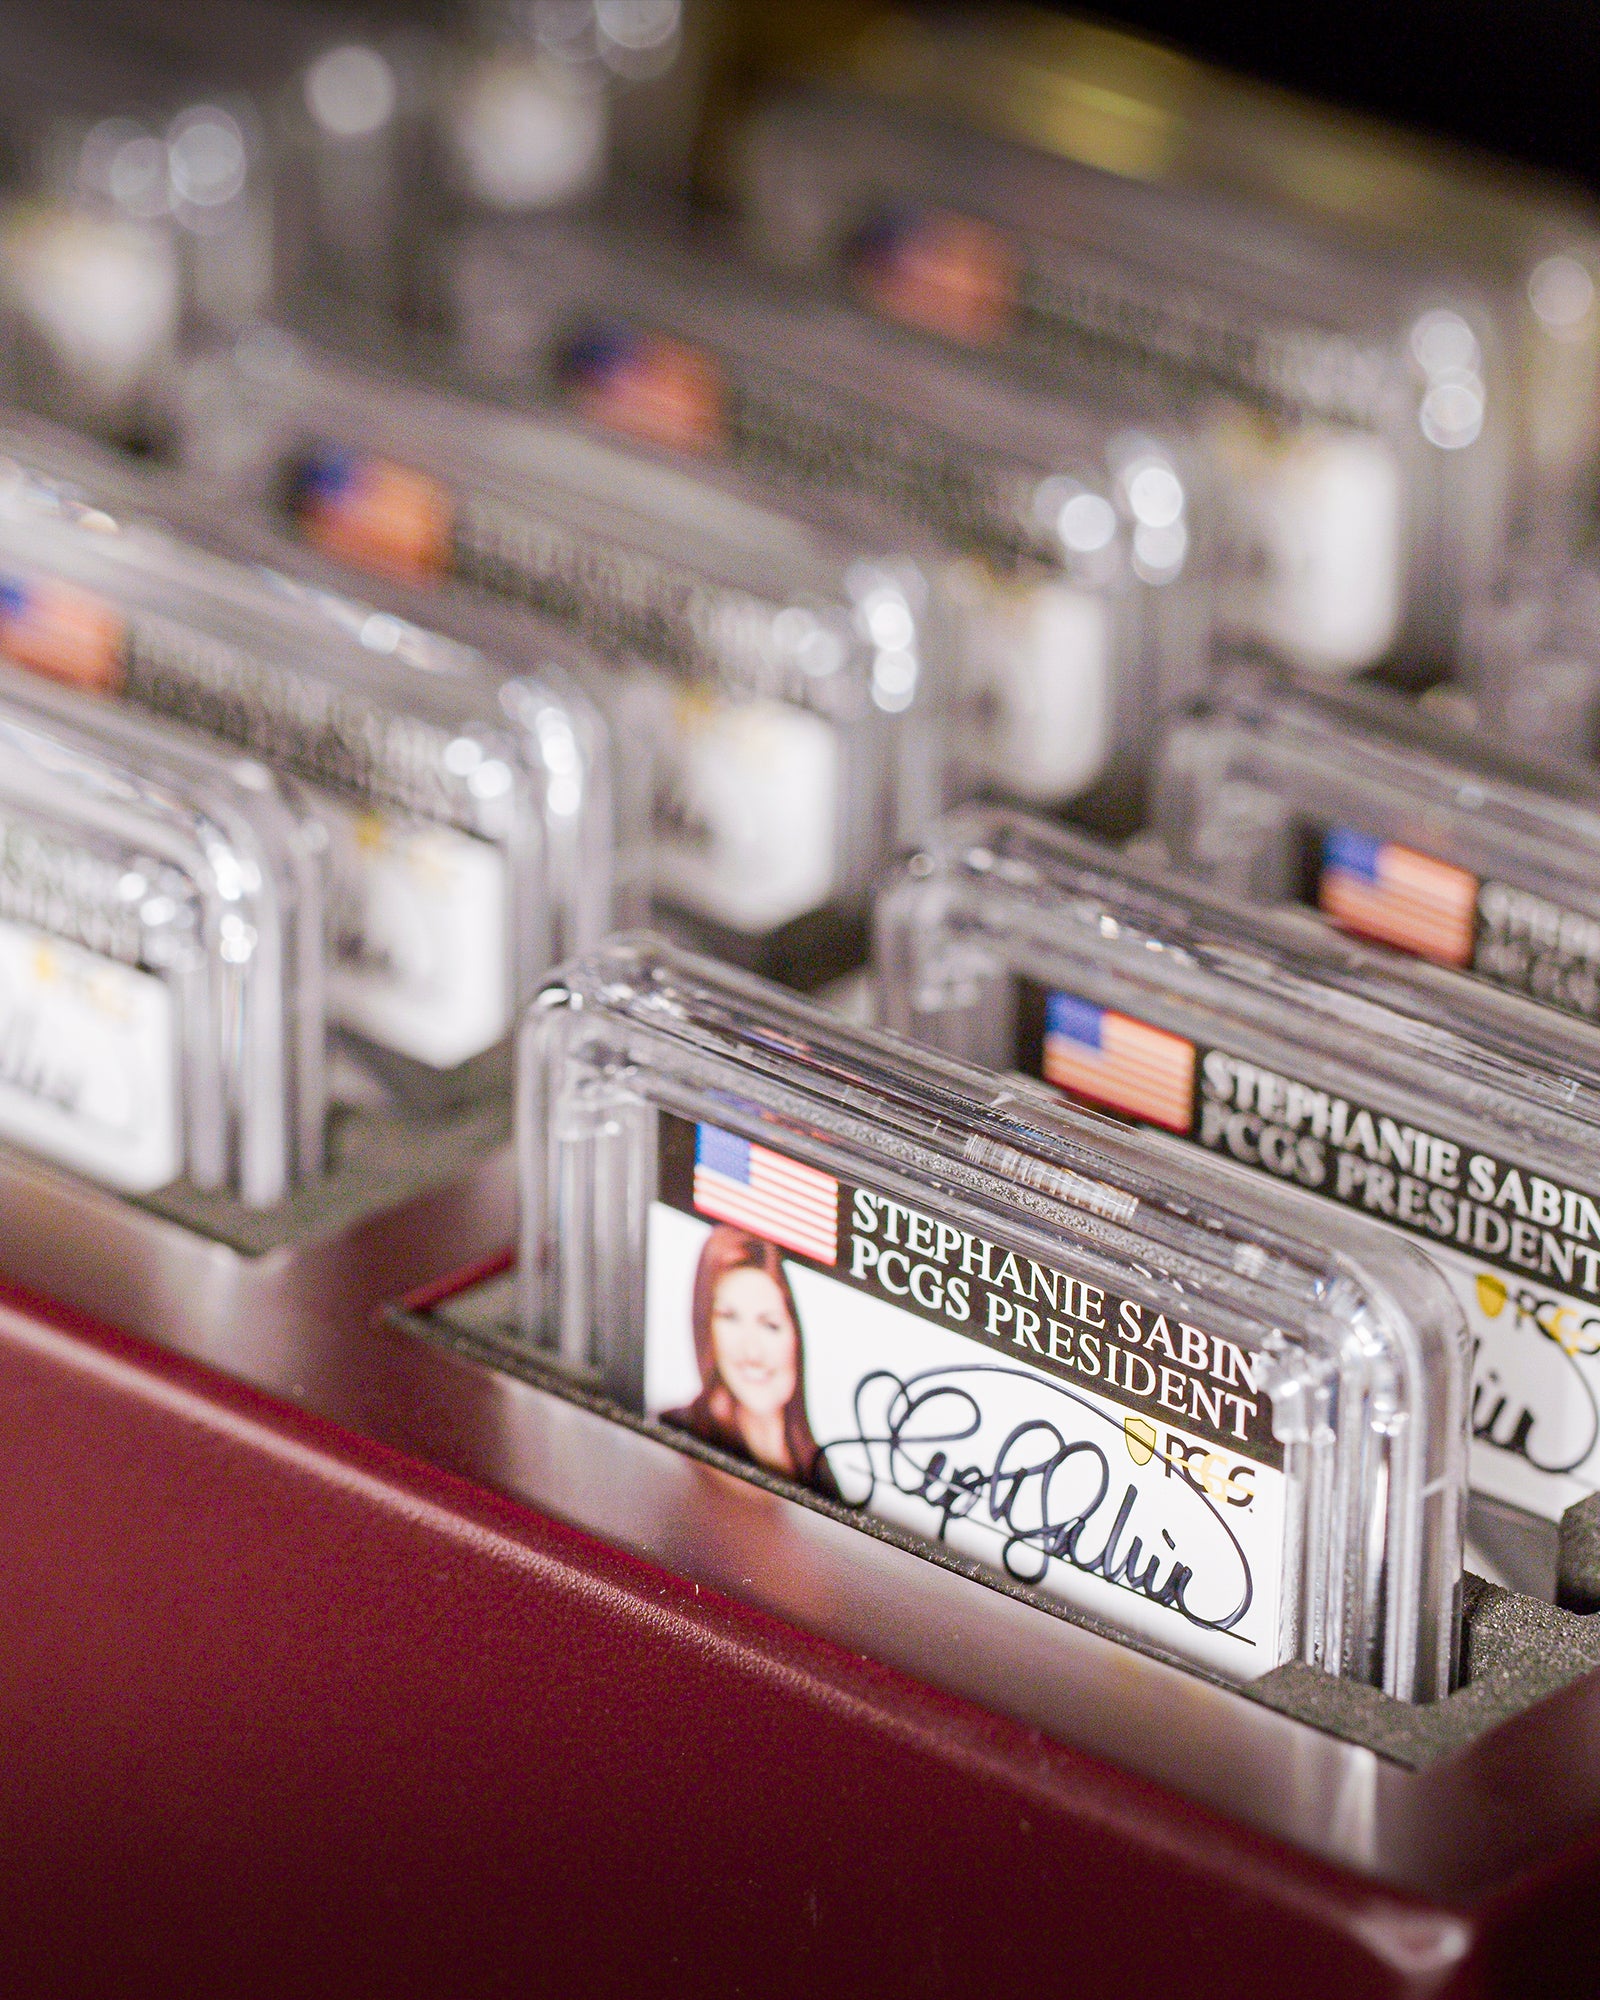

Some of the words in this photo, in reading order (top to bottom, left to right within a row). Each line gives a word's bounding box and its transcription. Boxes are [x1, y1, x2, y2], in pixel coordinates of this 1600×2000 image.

[1202, 1050, 1461, 1190] STEPHANIE
[1467, 1154, 1599, 1243] SABIN
[1336, 1152, 1599, 1295] PRESIDENT
[850, 1233, 971, 1322] PCGS
[984, 1291, 1258, 1442] PRESIDENT
[852, 1187, 1106, 1330] STEPHANIE
[1117, 1299, 1261, 1395] SABIN
